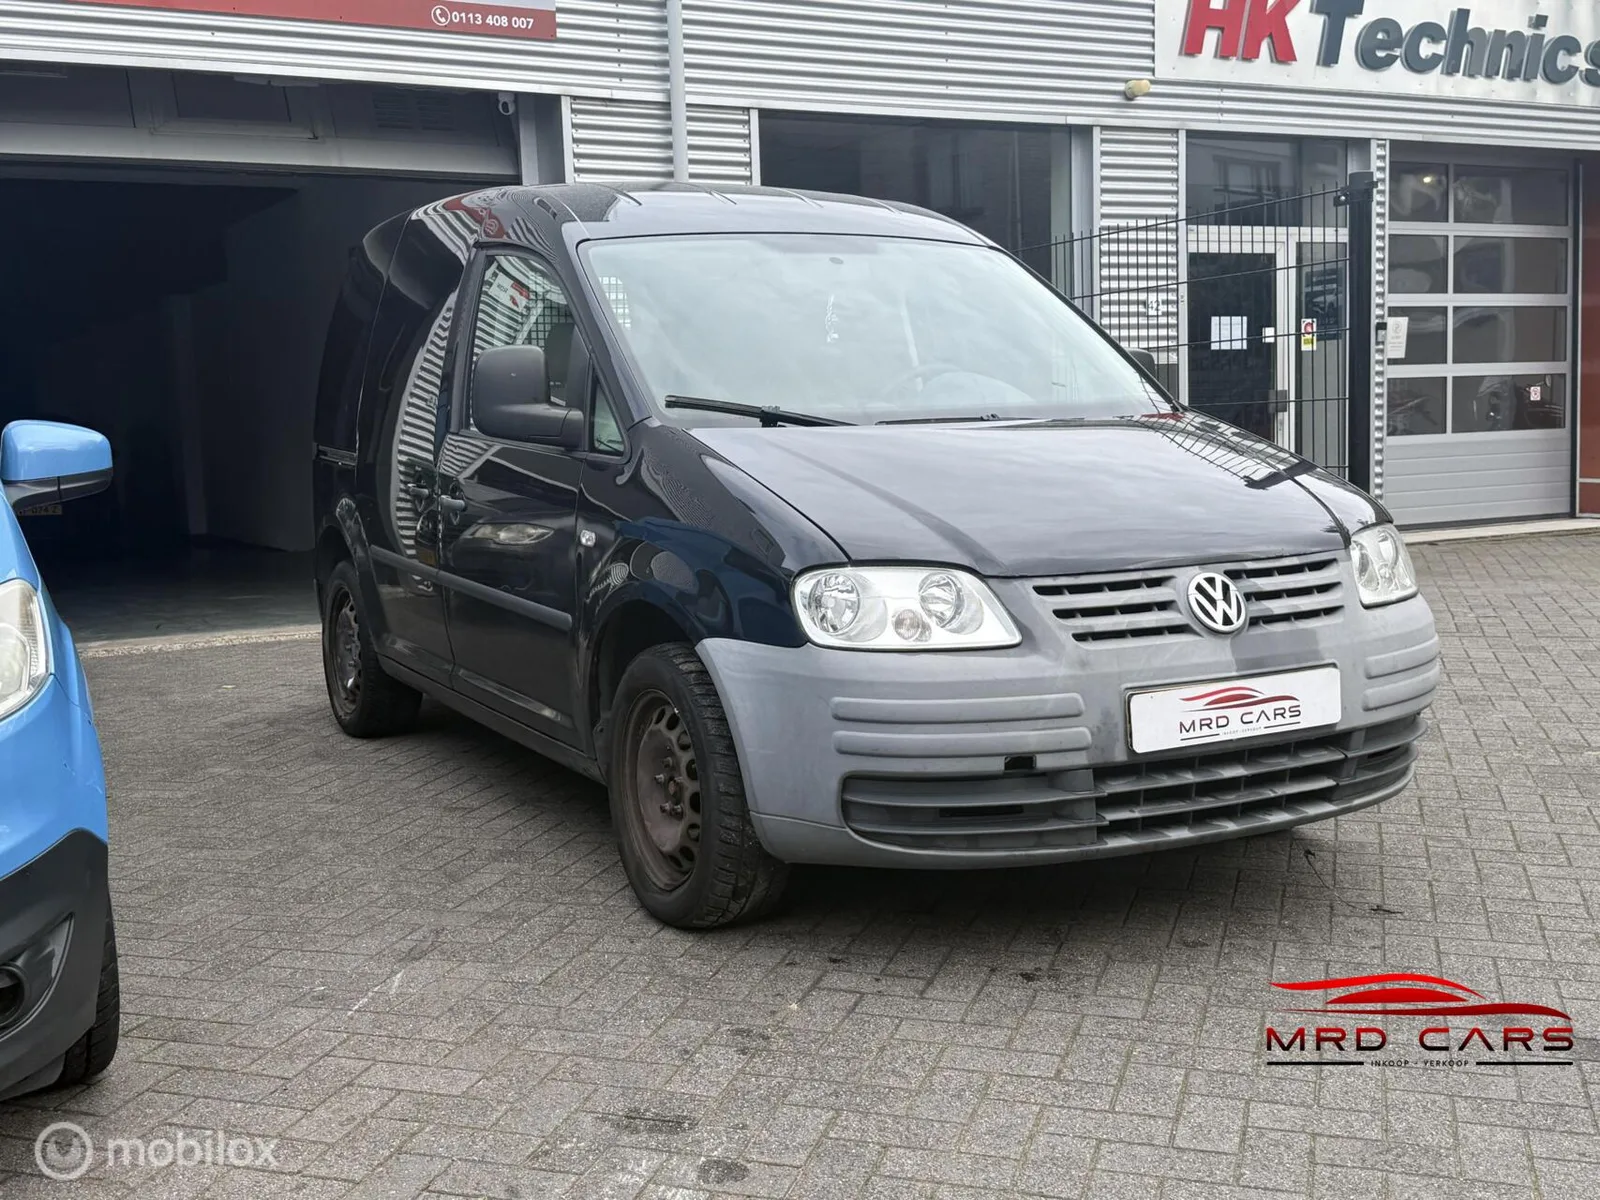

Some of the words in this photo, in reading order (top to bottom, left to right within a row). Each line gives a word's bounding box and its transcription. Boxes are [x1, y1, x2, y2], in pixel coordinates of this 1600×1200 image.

[451, 11, 482, 25] 0113
[485, 15, 509, 28] 408
[511, 17, 534, 30] 007
[1179, 0, 1300, 62] HK
[1179, 715, 1230, 734] MRD
[1240, 704, 1301, 725] CARS
